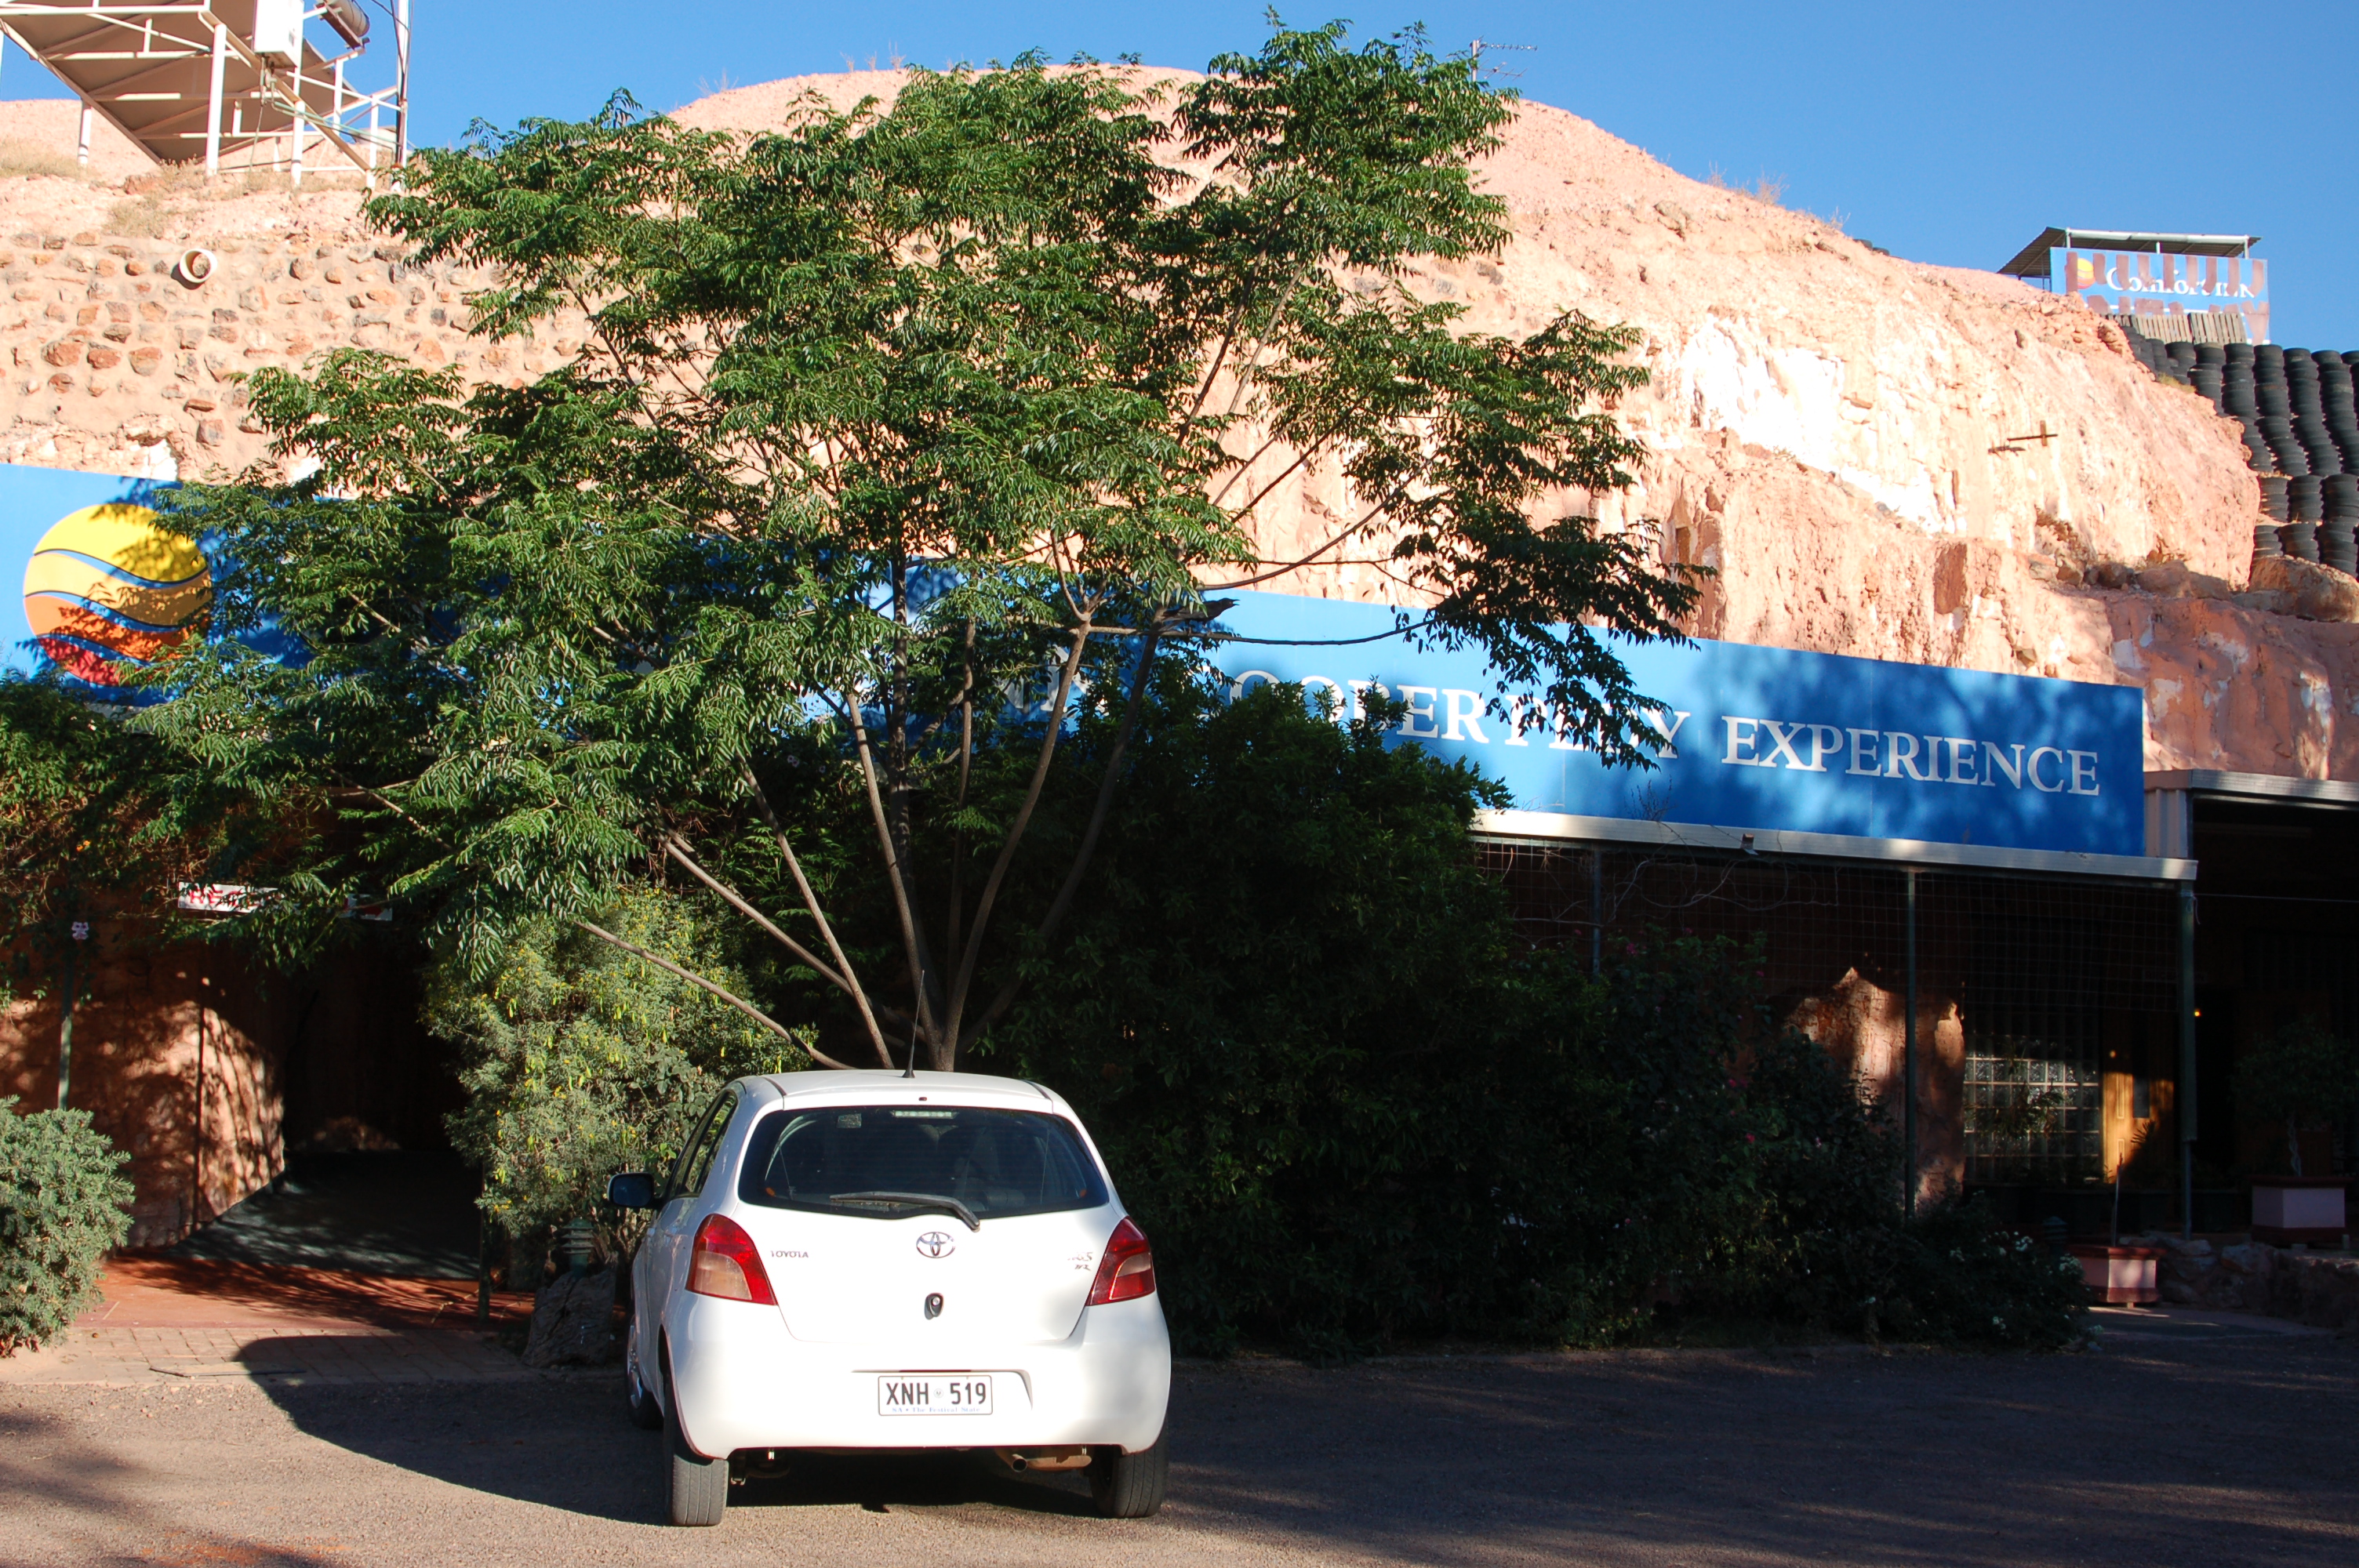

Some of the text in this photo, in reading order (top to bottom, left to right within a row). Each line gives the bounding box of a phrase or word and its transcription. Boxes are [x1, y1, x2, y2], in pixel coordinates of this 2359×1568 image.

[2106, 267, 2211, 296] Comort
[1186, 665, 1489, 744] OOER
[1721, 715, 2100, 797] EXPERIENCE
[770, 1250, 809, 1258] TOYOTA
[885, 1382, 987, 1406] XNH 519
